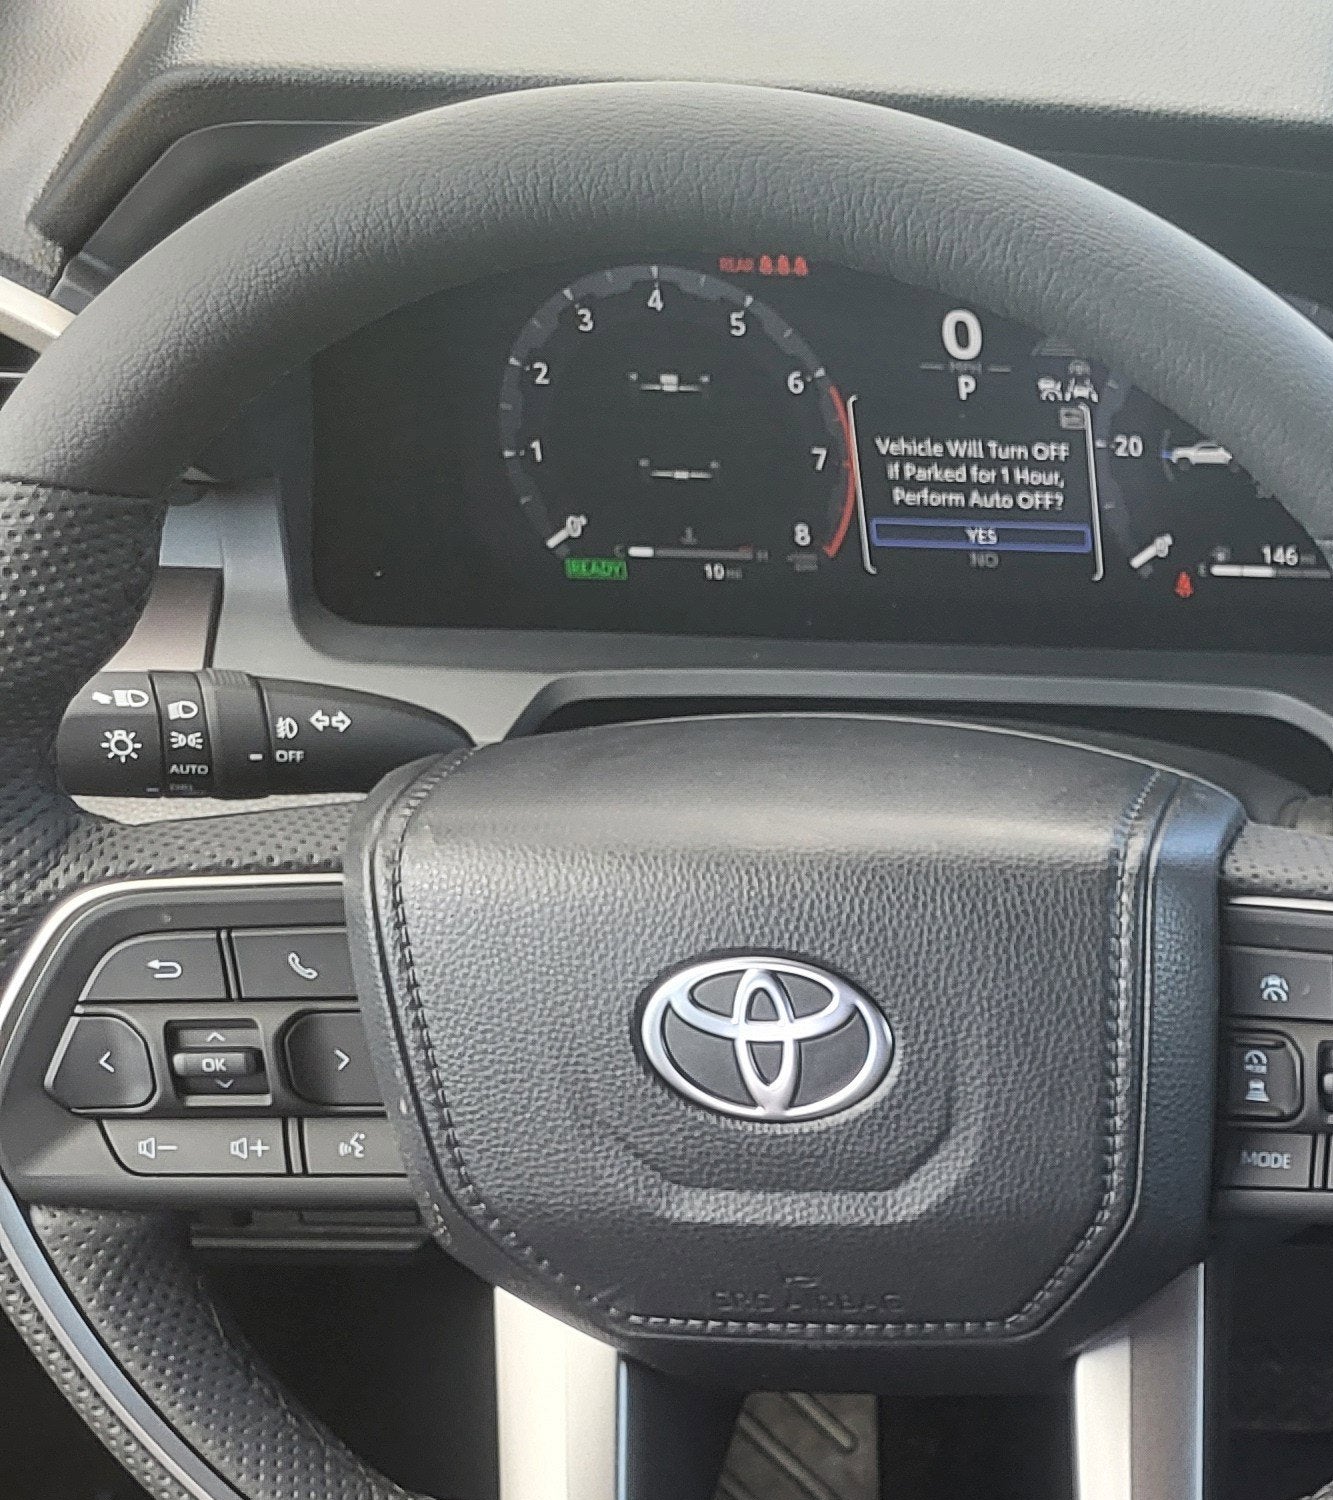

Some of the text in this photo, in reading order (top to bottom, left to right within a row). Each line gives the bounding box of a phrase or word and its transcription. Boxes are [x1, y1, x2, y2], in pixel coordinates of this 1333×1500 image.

[647, 289, 663, 312] 4
[577, 308, 594, 332] 3
[729, 311, 747, 337] 5
[941, 308, 983, 361] 0
[532, 363, 550, 385] 2
[787, 371, 804, 394] 6
[957, 374, 977, 401] P
[529, 440, 543, 463] 1
[874, 435, 1071, 462] Vehicle Will Turn OFF
[1114, 434, 1144, 457] 20
[811, 447, 829, 471] 7
[903, 461, 967, 483] Parked
[969, 464, 997, 484] for
[1001, 465, 1010, 484] 1
[1013, 466, 1065, 489] Hour,
[892, 485, 1065, 512] Perform Auto OFF?
[793, 522, 811, 546] 8
[963, 526, 999, 545] YES
[968, 551, 1000, 569] NO
[1261, 545, 1299, 566] 146
[704, 562, 726, 581] 10
[275, 749, 305, 765] OFF
[169, 763, 210, 775] AUTO
[201, 1057, 227, 1073] OK
[1240, 1150, 1292, 1171] MODE
